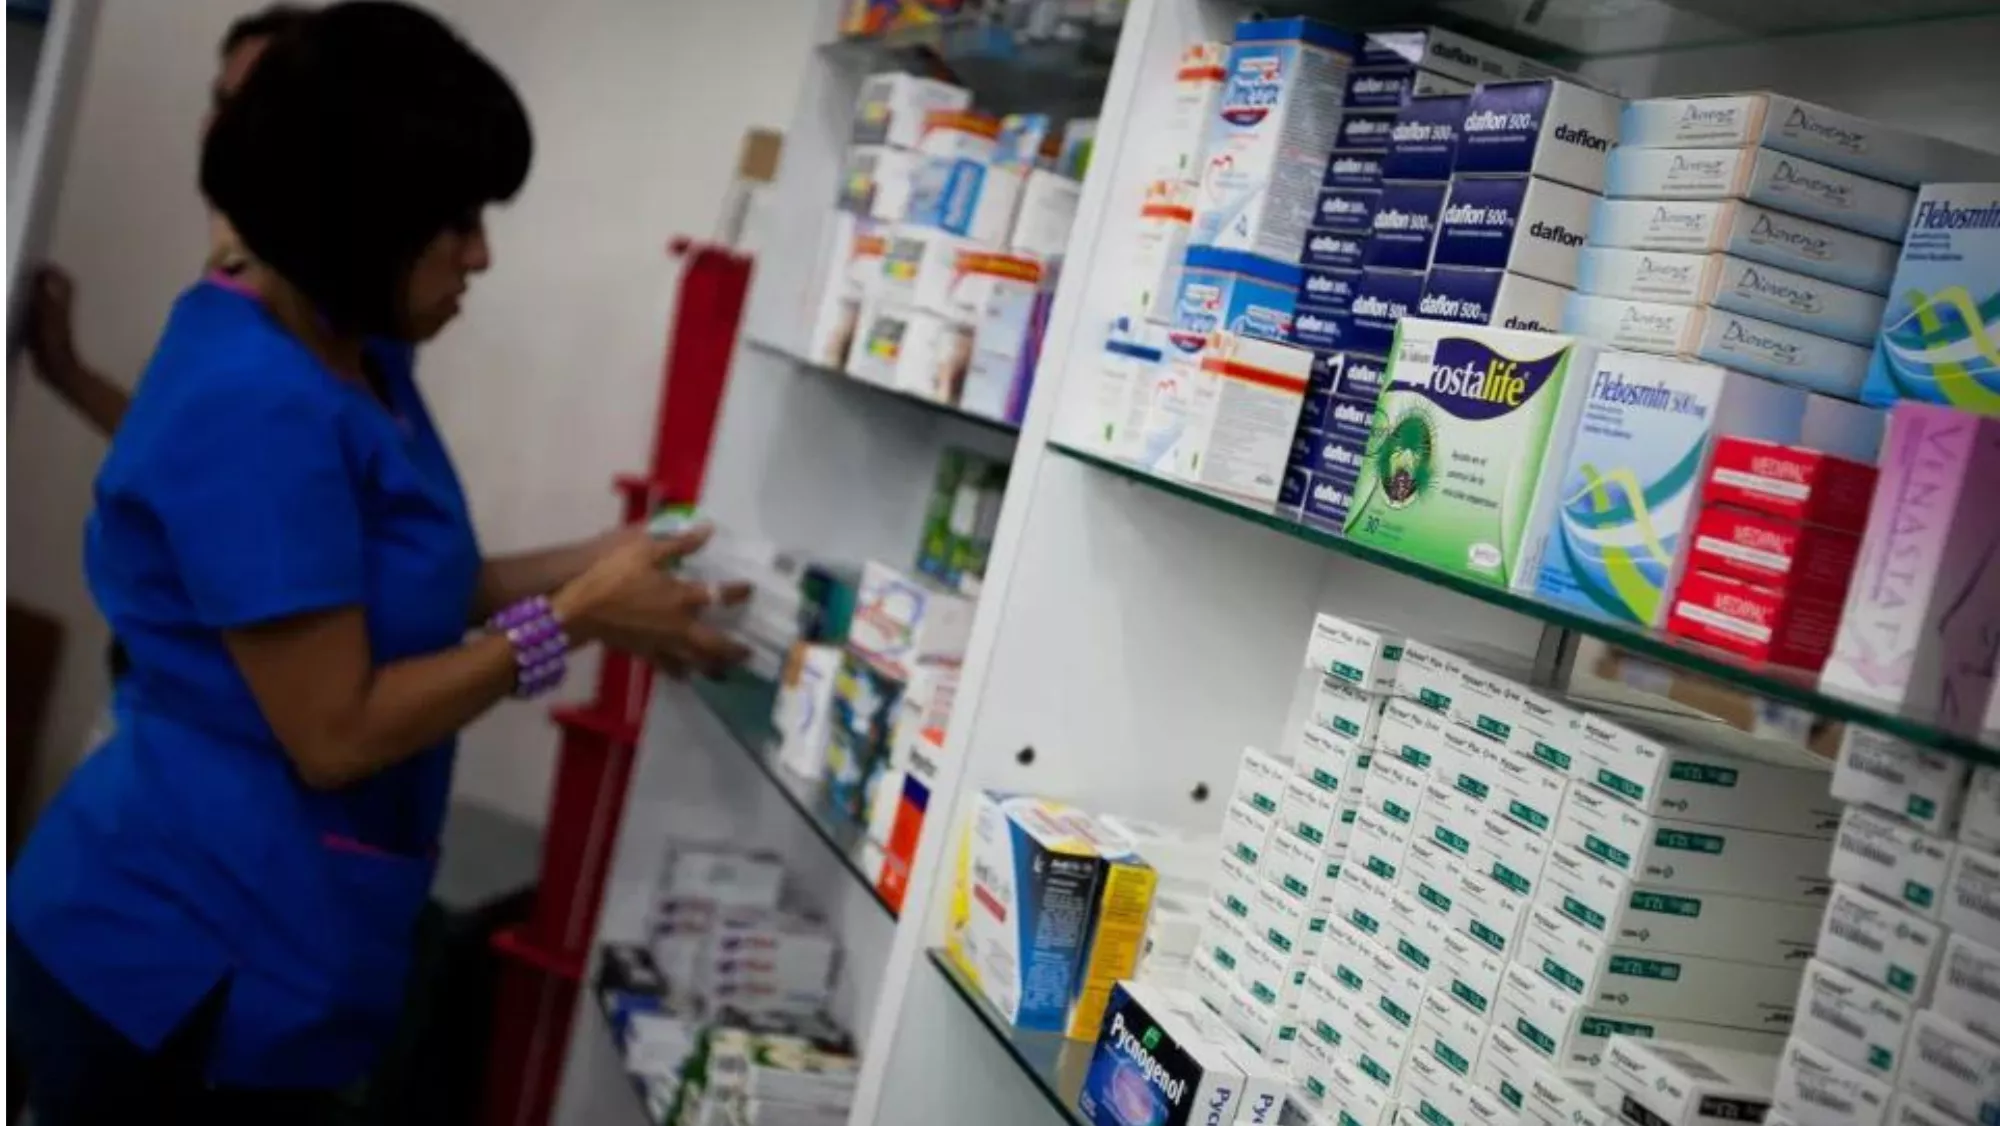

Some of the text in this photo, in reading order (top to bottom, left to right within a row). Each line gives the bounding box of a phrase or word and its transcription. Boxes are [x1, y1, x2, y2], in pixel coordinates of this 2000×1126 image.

[1464, 110, 1507, 132] daflon
[1508, 112, 1531, 130] 500
[1554, 123, 1607, 153] daflon
[1444, 203, 1485, 225] daflon
[1487, 208, 1508, 226] 500
[1529, 220, 1584, 248] daflon
[1419, 293, 1458, 317] daflon
[1459, 300, 1481, 319] 500
[1410, 358, 1526, 407] rostalife
[1109, 1011, 1187, 1106] Pycnogenol
